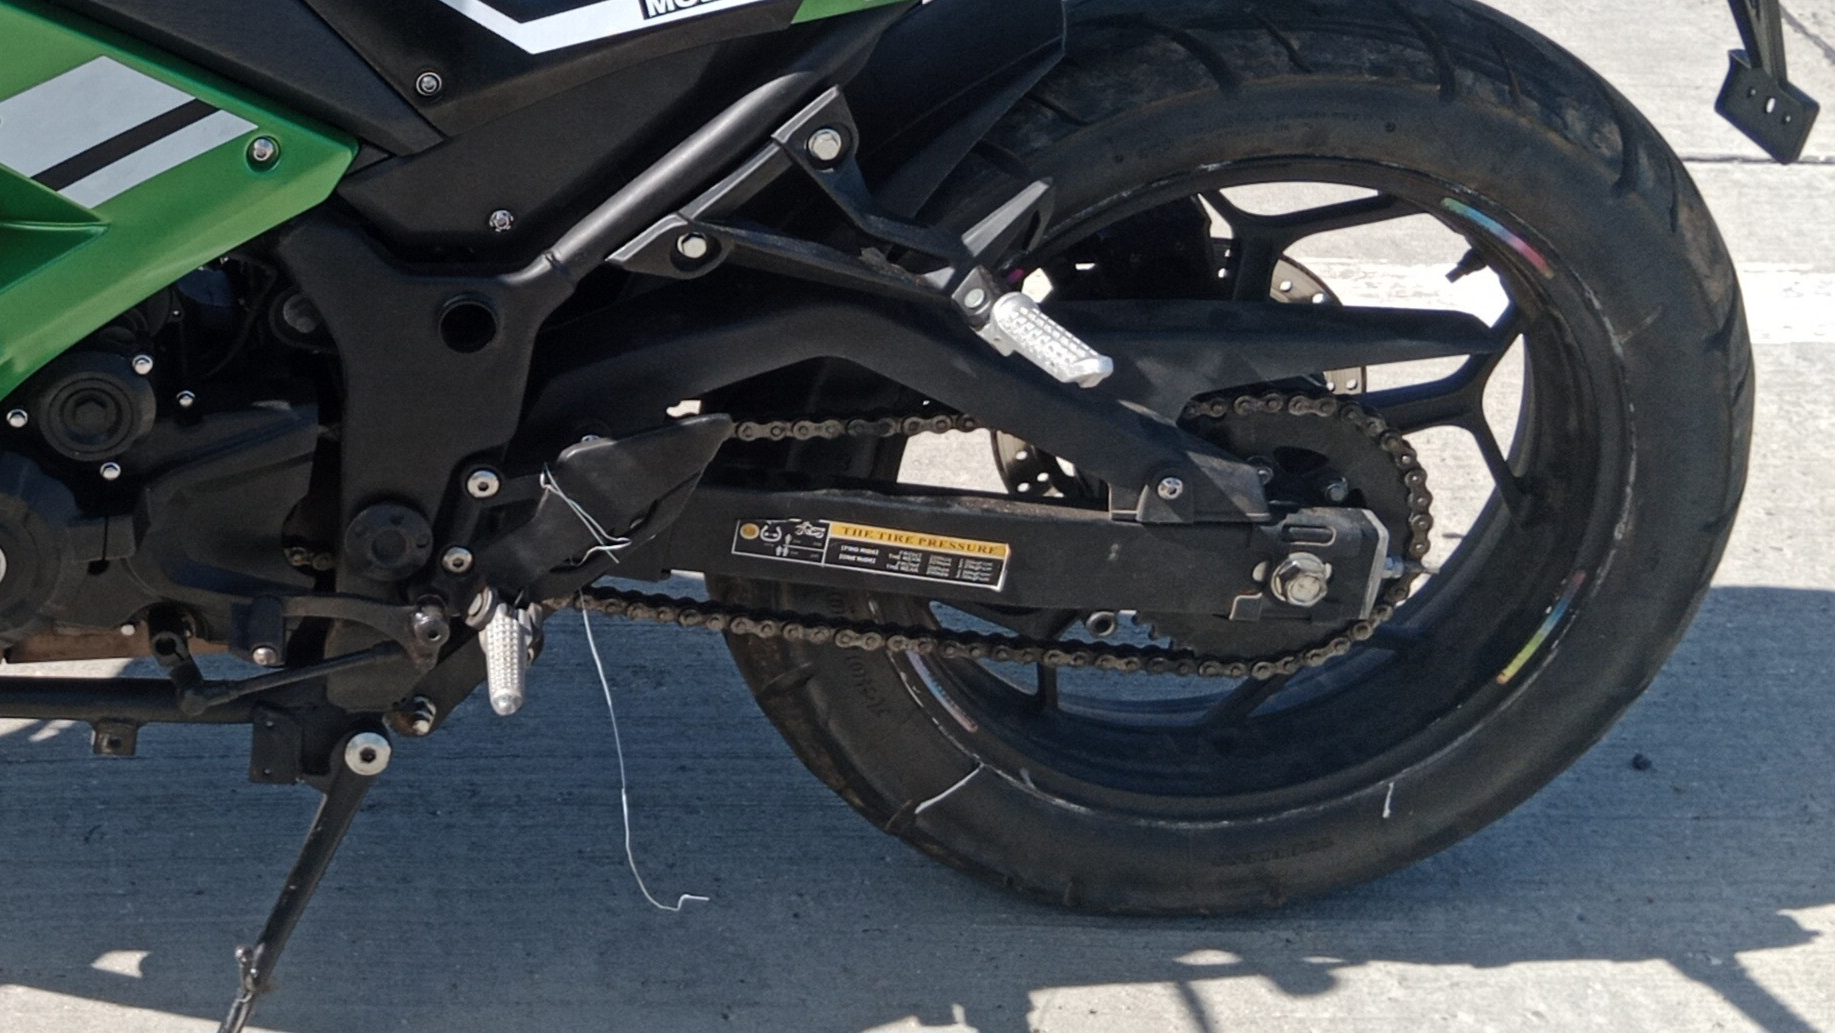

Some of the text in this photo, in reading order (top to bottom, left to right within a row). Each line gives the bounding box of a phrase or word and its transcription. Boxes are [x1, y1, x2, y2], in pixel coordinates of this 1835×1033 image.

[842, 526, 999, 555] THE TIRE PRESSURE
